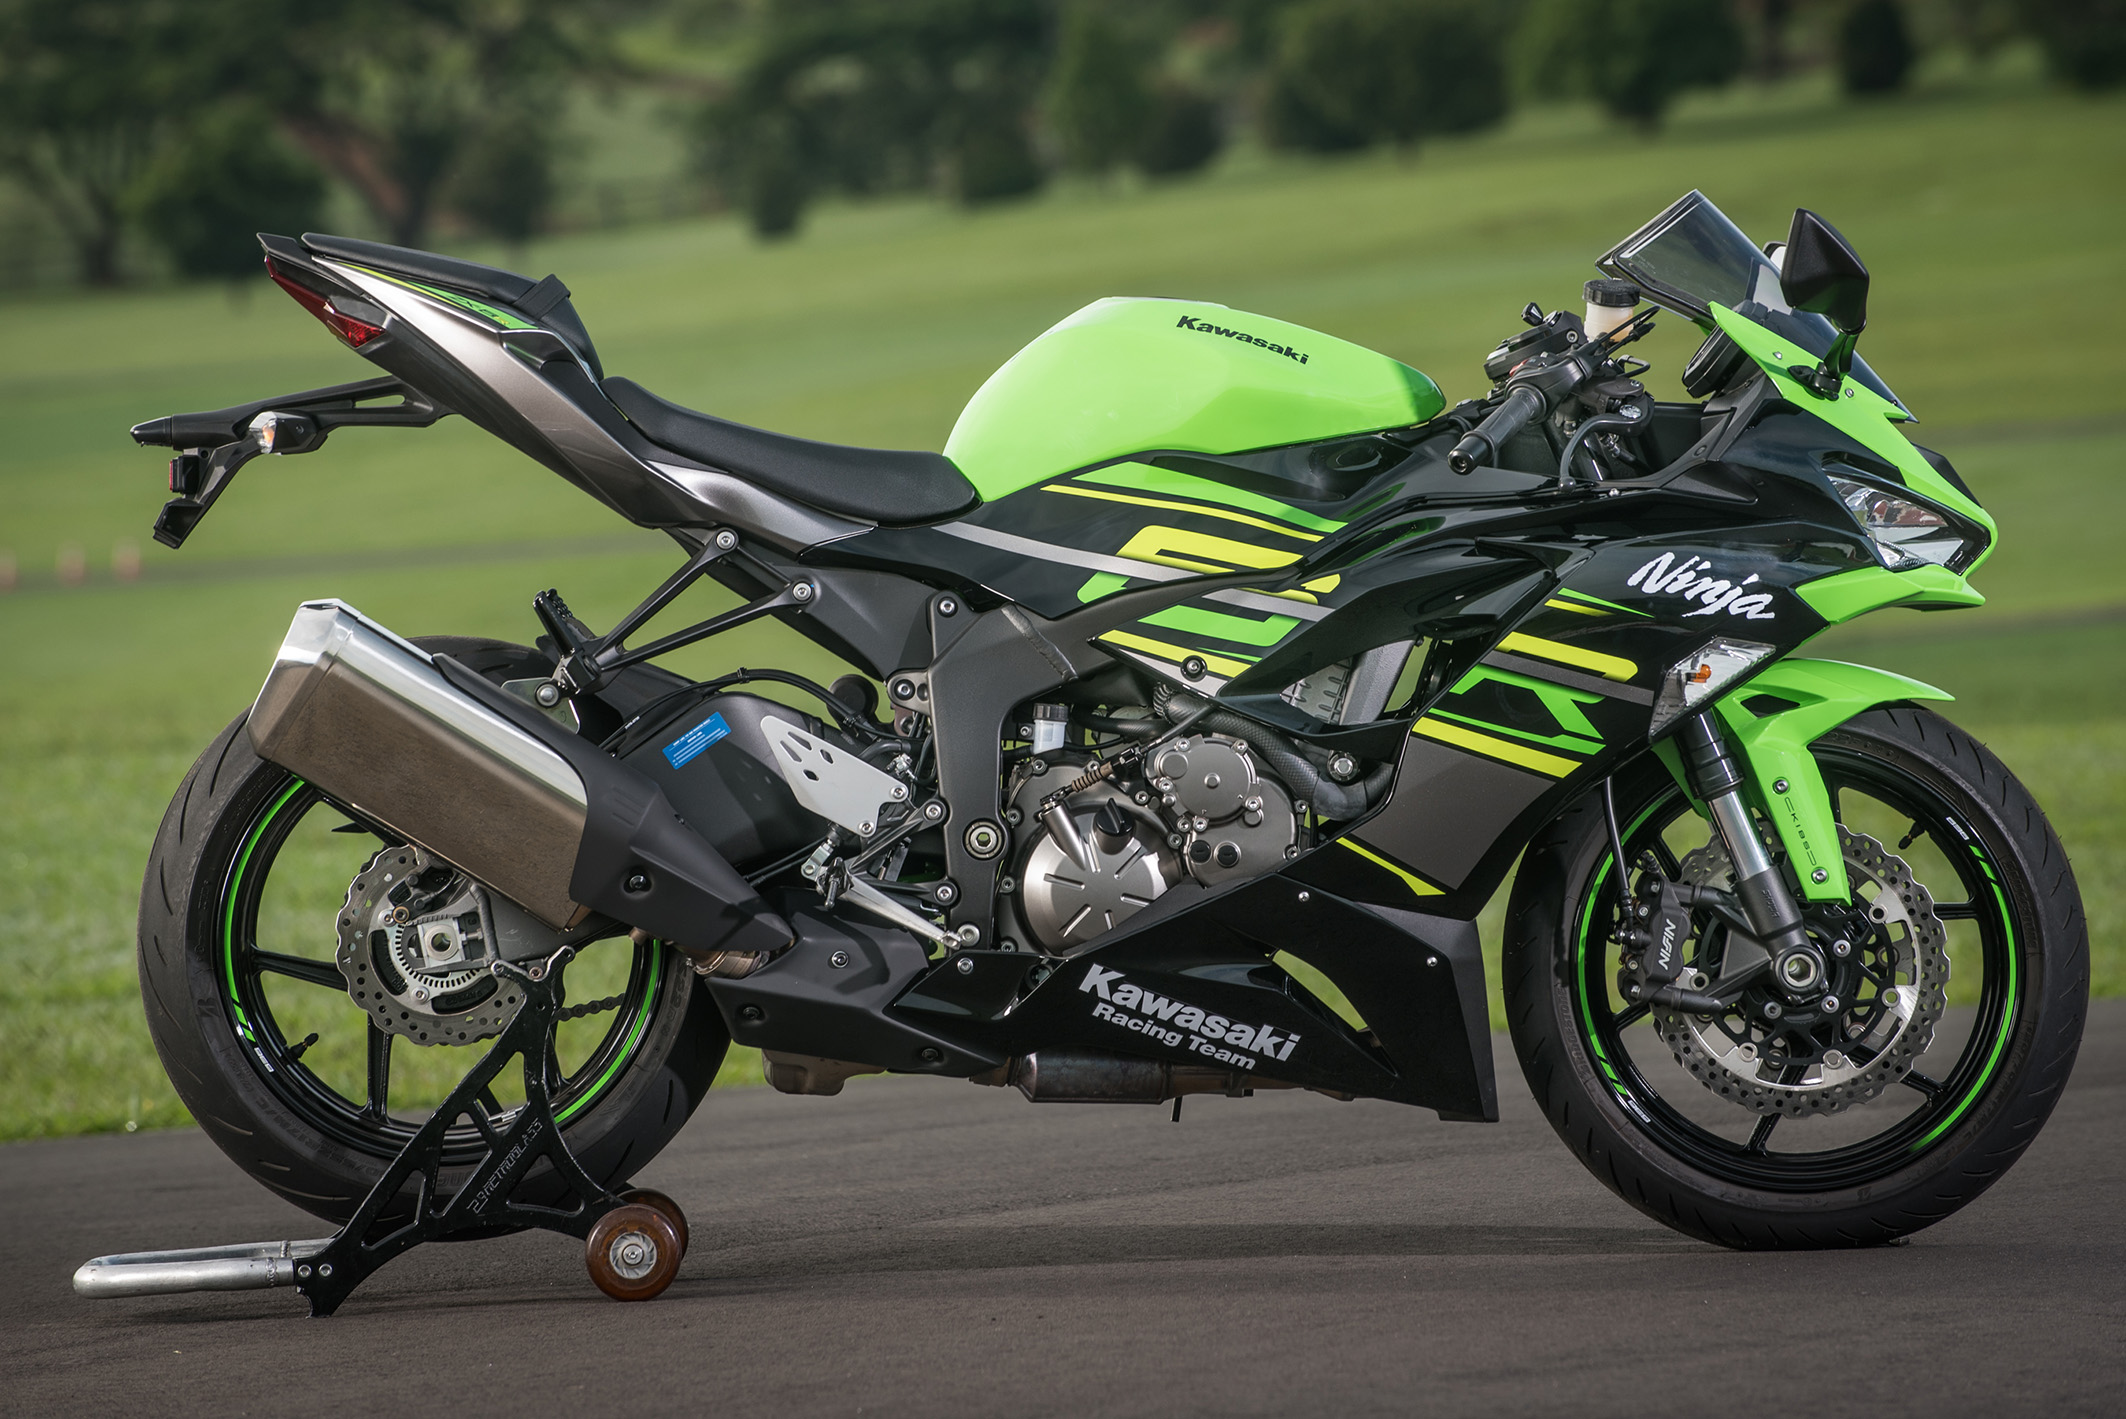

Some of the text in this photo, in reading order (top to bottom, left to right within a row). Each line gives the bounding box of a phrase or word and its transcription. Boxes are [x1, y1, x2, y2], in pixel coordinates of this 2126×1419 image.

[1176, 315, 1309, 365] Kawasaki
[1627, 551, 1775, 620] Ninja
[1658, 918, 1676, 971] NISSIN
[1078, 963, 1301, 1062] Kawasaki
[1092, 1002, 1257, 1070] Racing Team
